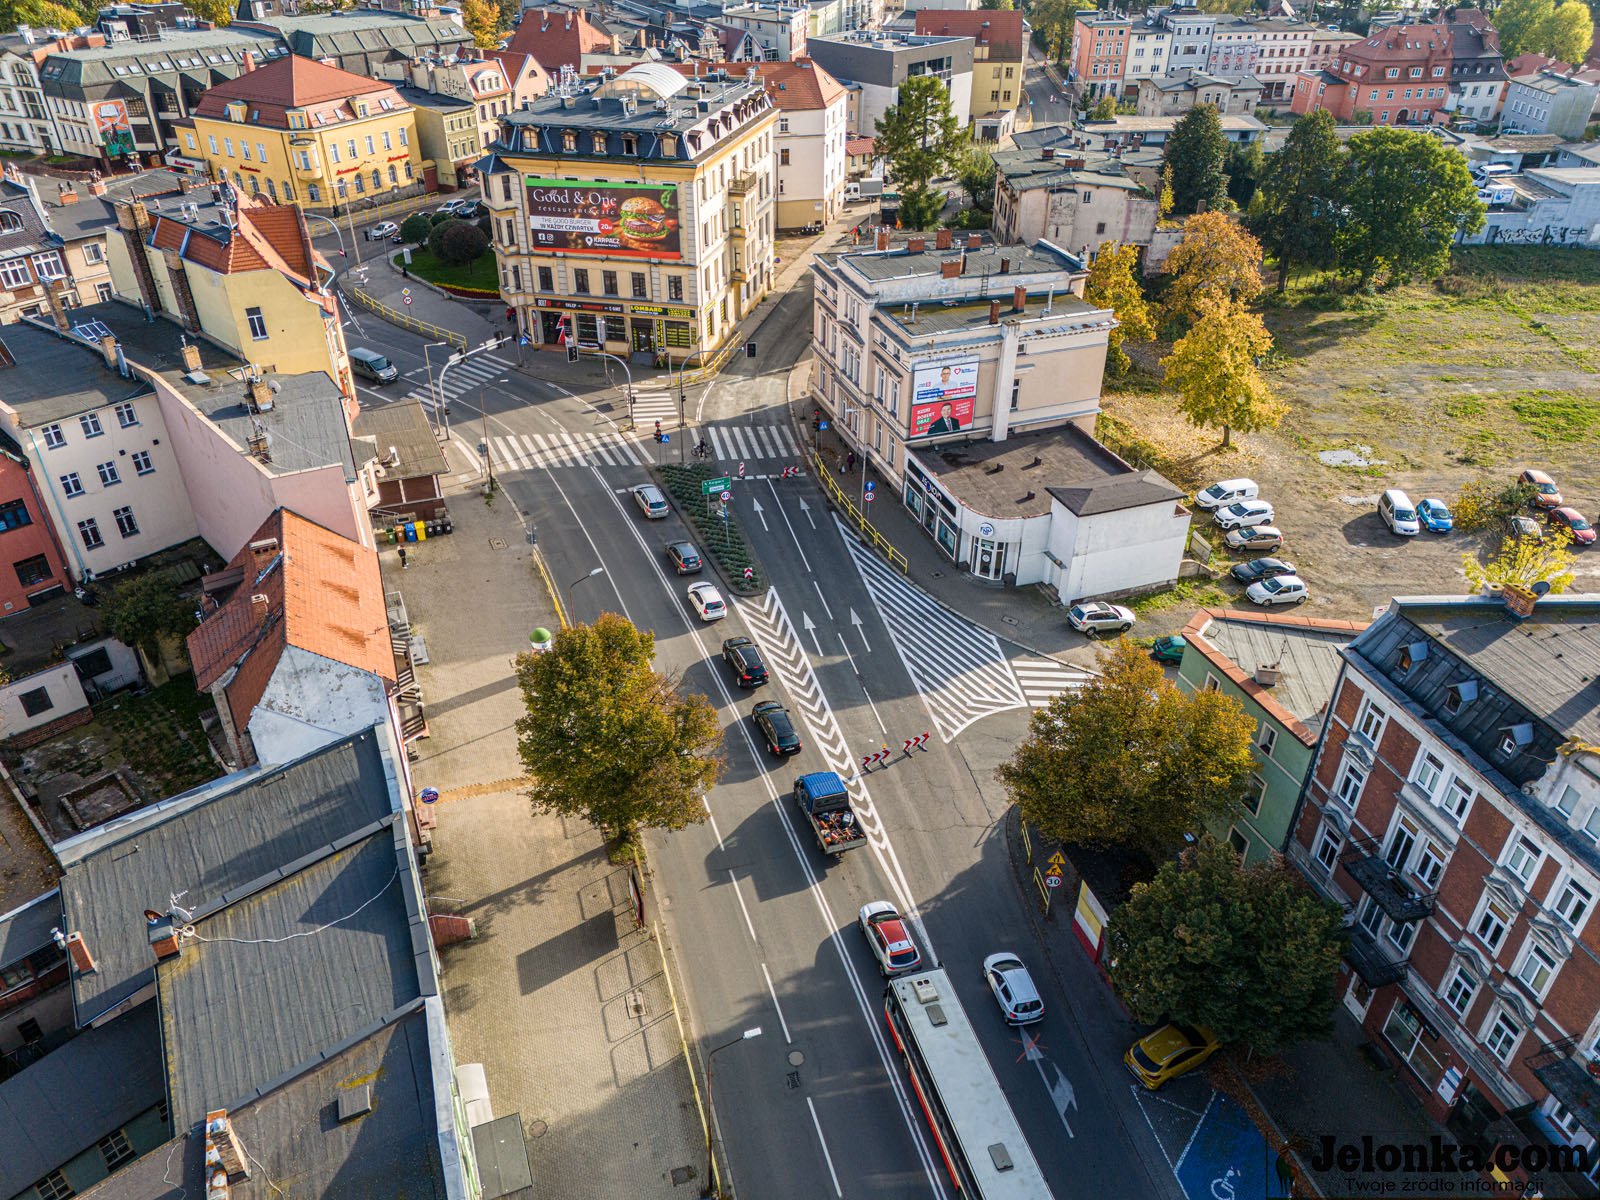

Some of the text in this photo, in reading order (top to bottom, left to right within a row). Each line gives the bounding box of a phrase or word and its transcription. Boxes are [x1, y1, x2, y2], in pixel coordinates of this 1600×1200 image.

[533, 189, 617, 206] Good & One
[630, 305, 663, 313] LOMBARD
